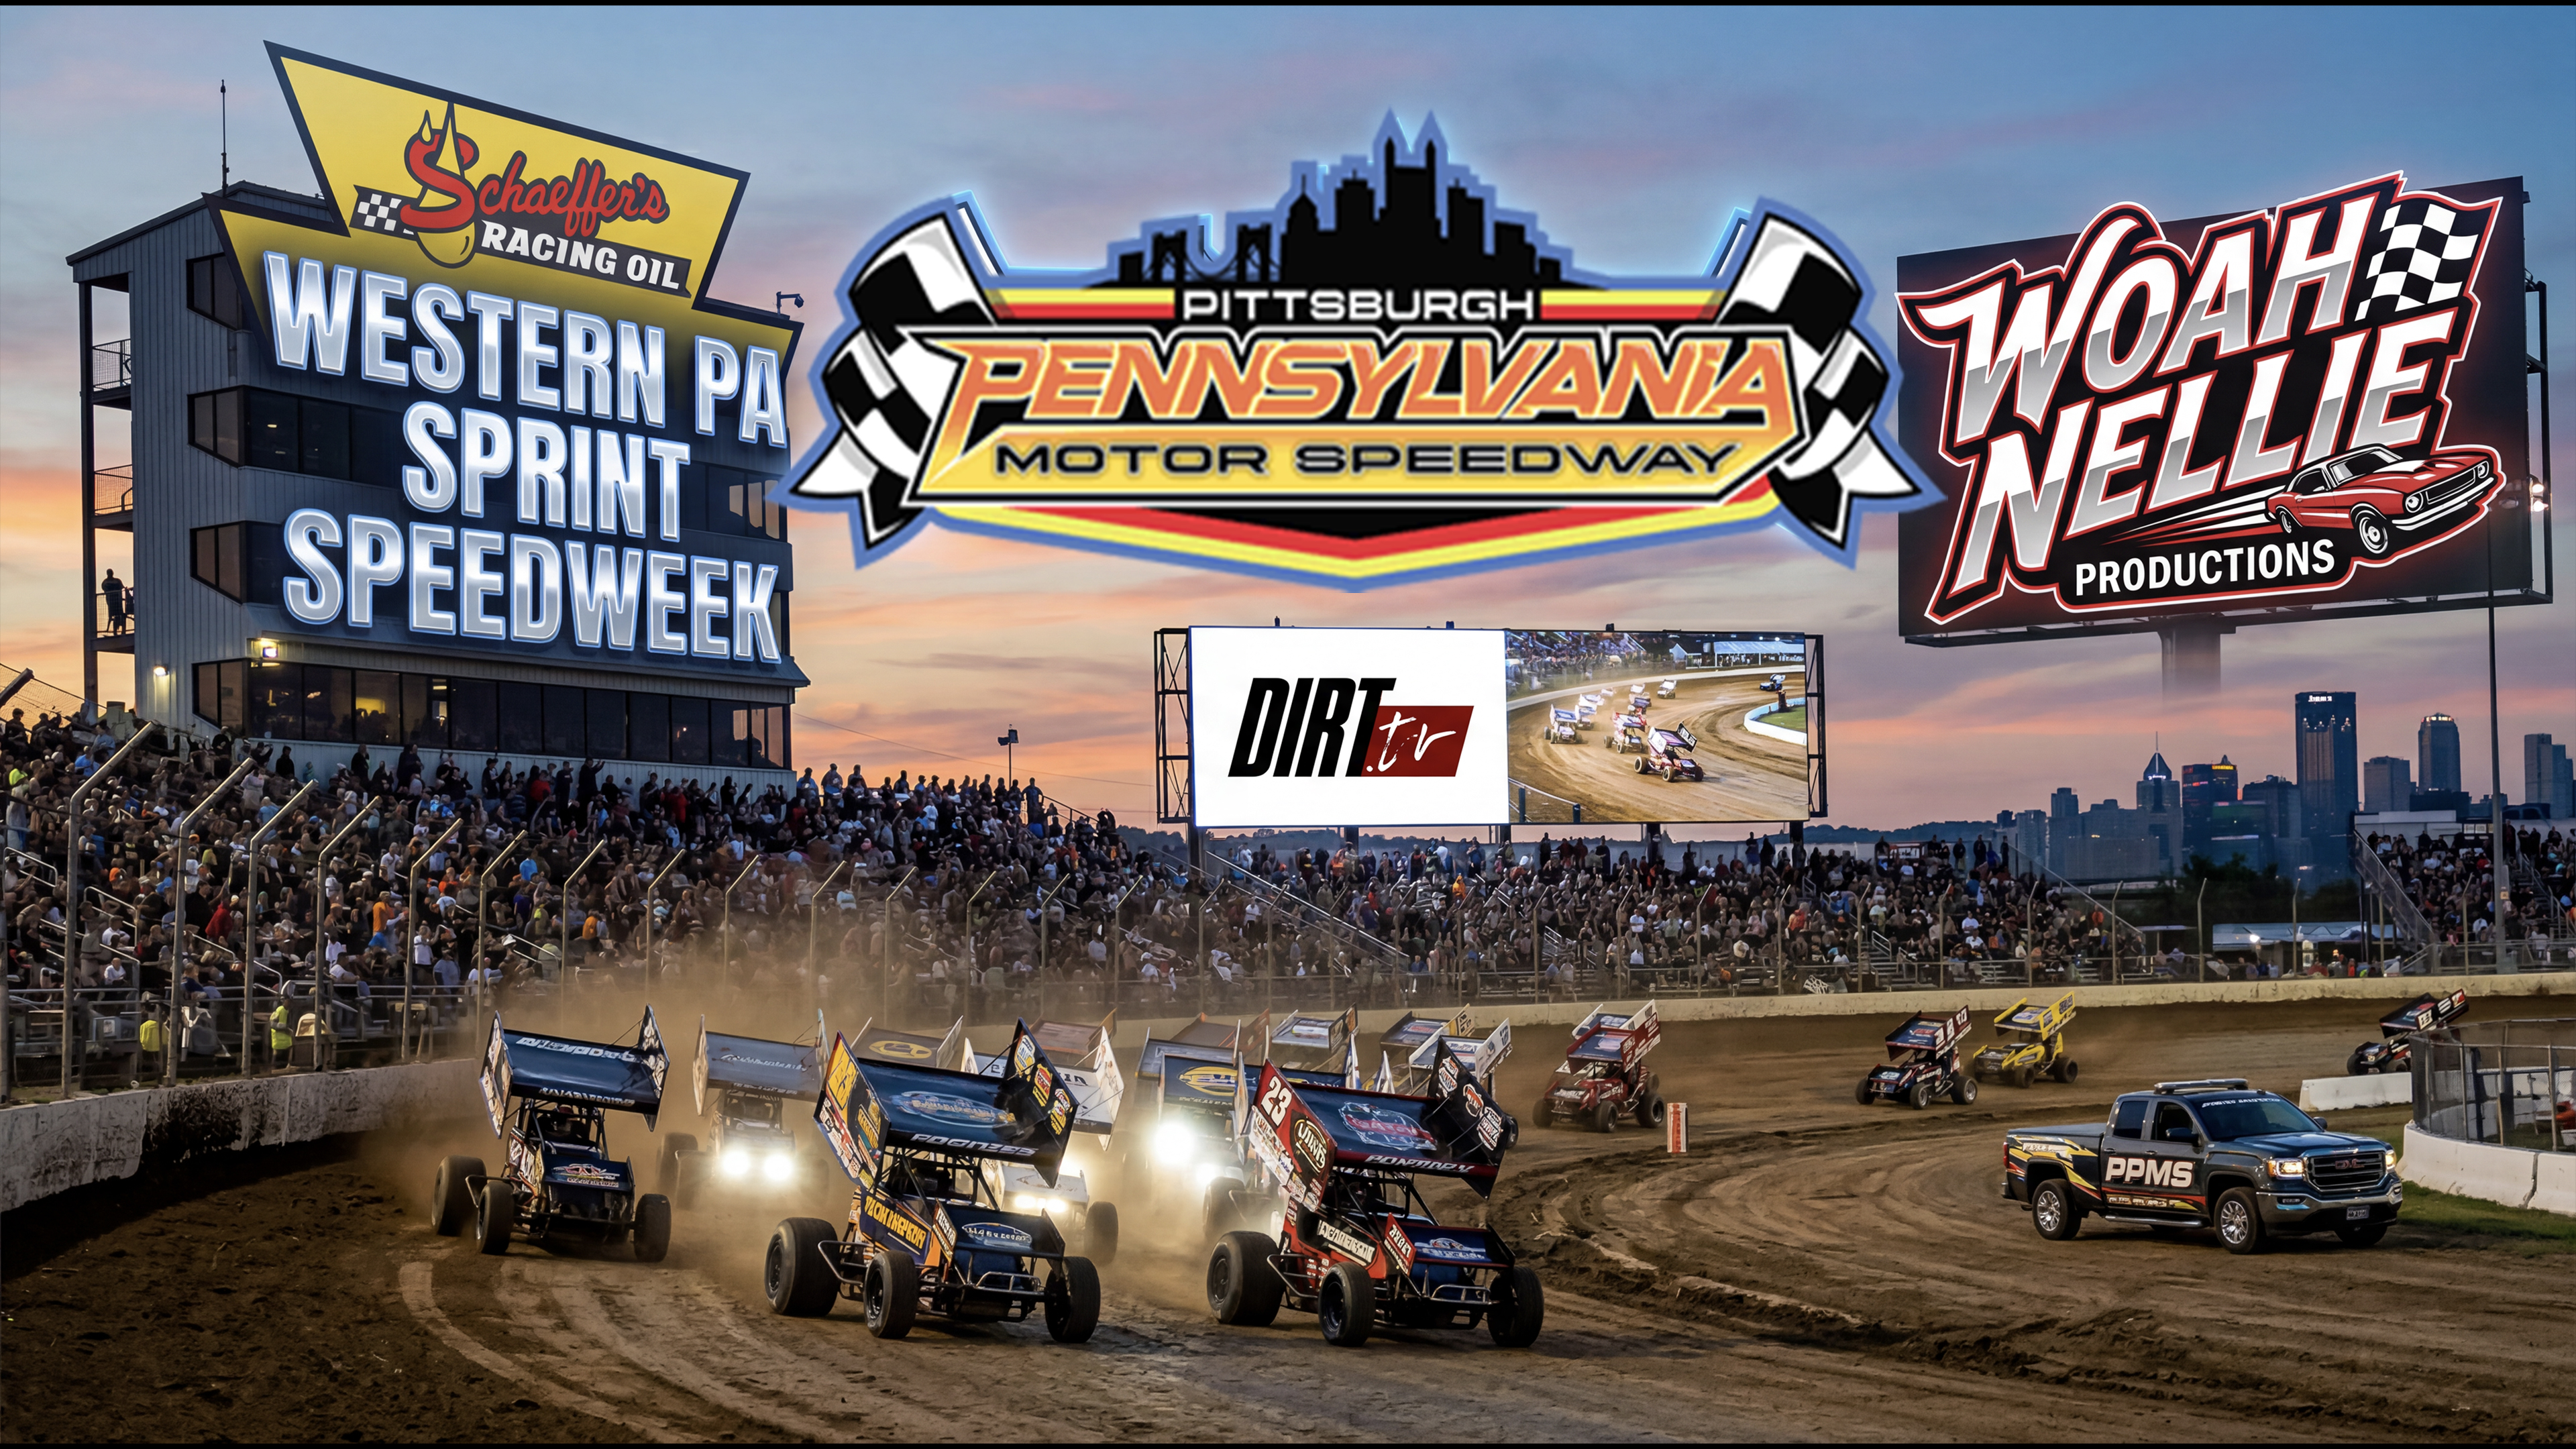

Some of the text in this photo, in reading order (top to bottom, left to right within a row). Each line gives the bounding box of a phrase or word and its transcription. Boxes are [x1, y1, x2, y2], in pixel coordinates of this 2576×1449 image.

[400, 134, 667, 237] Schaeffer's
[481, 219, 680, 290] RACING OIL
[263, 250, 788, 448] WESTERN PA
[1916, 192, 2383, 445] WOAH
[402, 401, 690, 542] SPRINT
[1948, 309, 2458, 596] NELLIE
[283, 508, 782, 664] SPEEDWEEK
[2076, 539, 2335, 596] PRODUCTIONS
[1260, 1075, 1293, 1127] 23
[2104, 1156, 2194, 1188] PPMS
